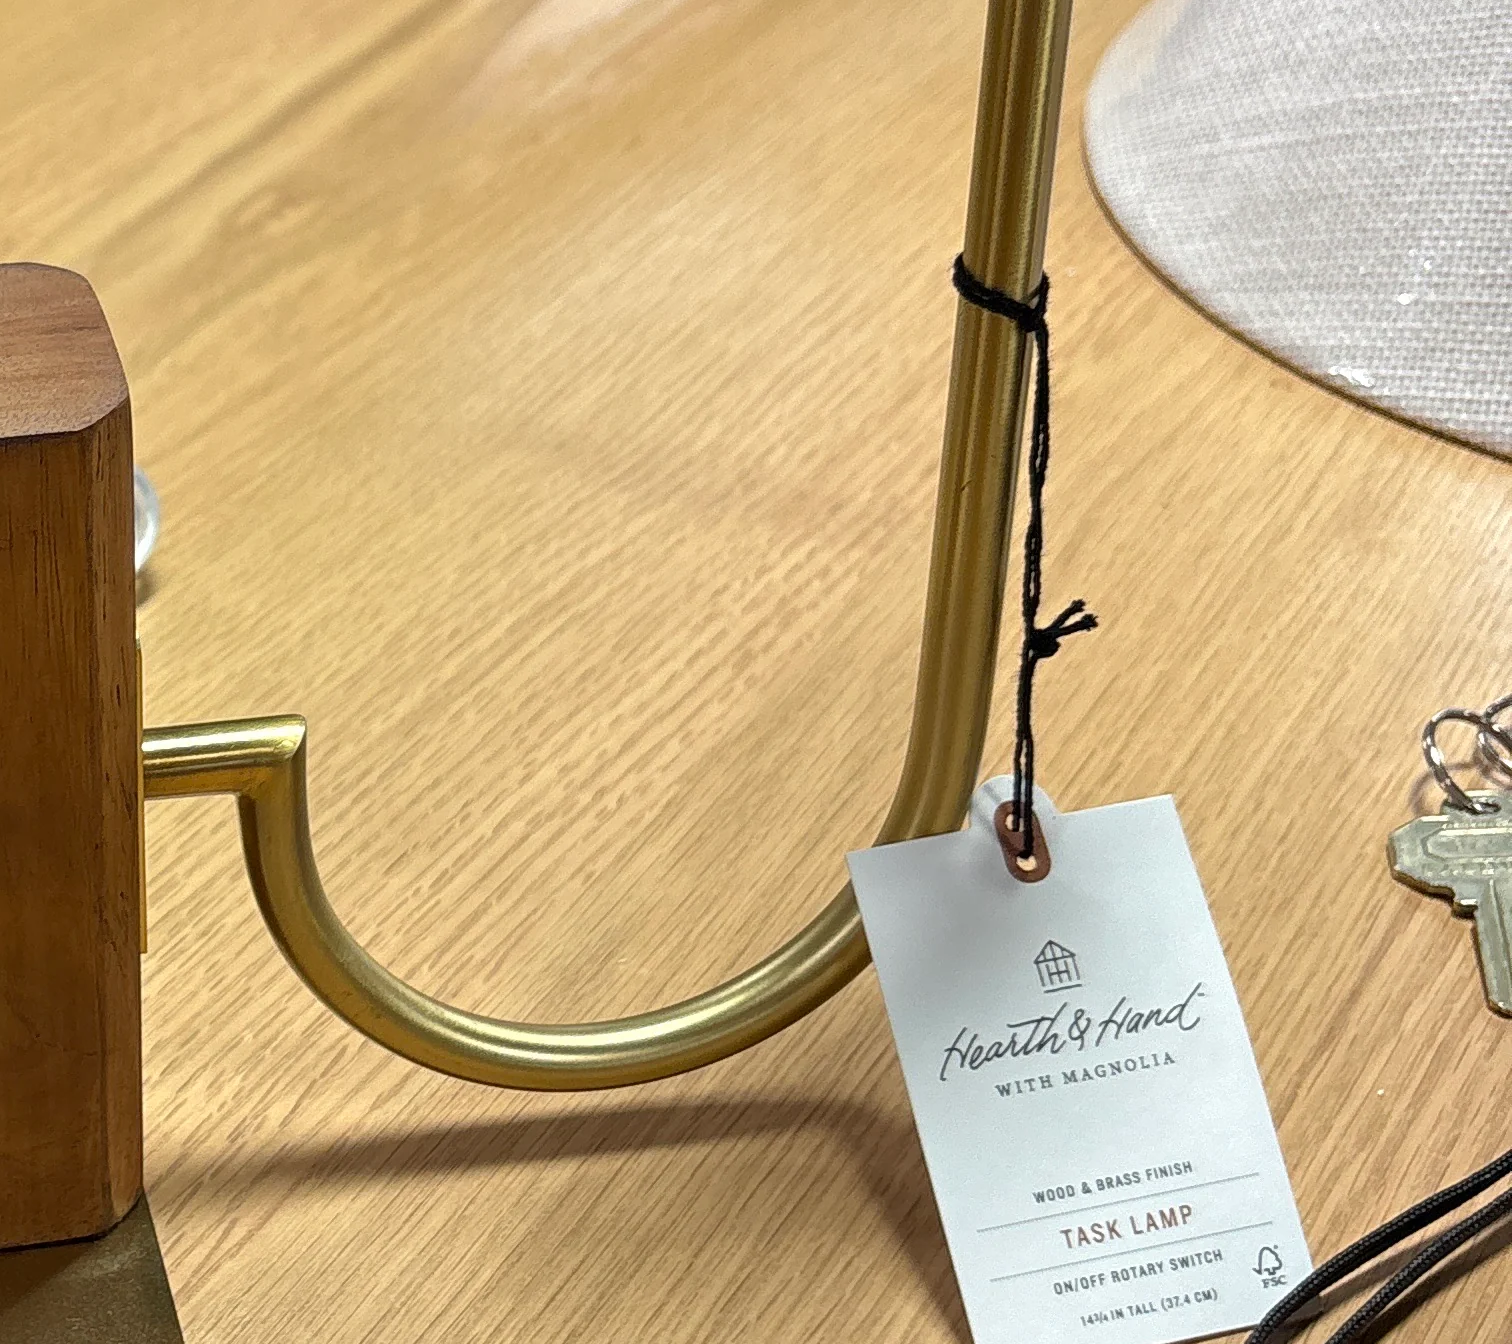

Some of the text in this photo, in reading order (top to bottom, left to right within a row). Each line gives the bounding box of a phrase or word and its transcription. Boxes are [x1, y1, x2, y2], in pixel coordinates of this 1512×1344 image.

[939, 982, 1203, 1082] Hearth & Hand
[994, 1051, 1176, 1098] WITH MAGNOLIA
[1032, 1160, 1193, 1204] WOOD & BRASS FINISH
[1059, 1204, 1193, 1249] TASK LAMP
[1053, 1249, 1224, 1295] ON/OFF ROTARY SWITCH
[1261, 1274, 1287, 1289] FSC
[1109, 1308, 1125, 1321] IN
[1128, 1301, 1158, 1318] TALL
[1160, 1294, 1191, 1313] (37.4
[1194, 1287, 1219, 1304] CM)
